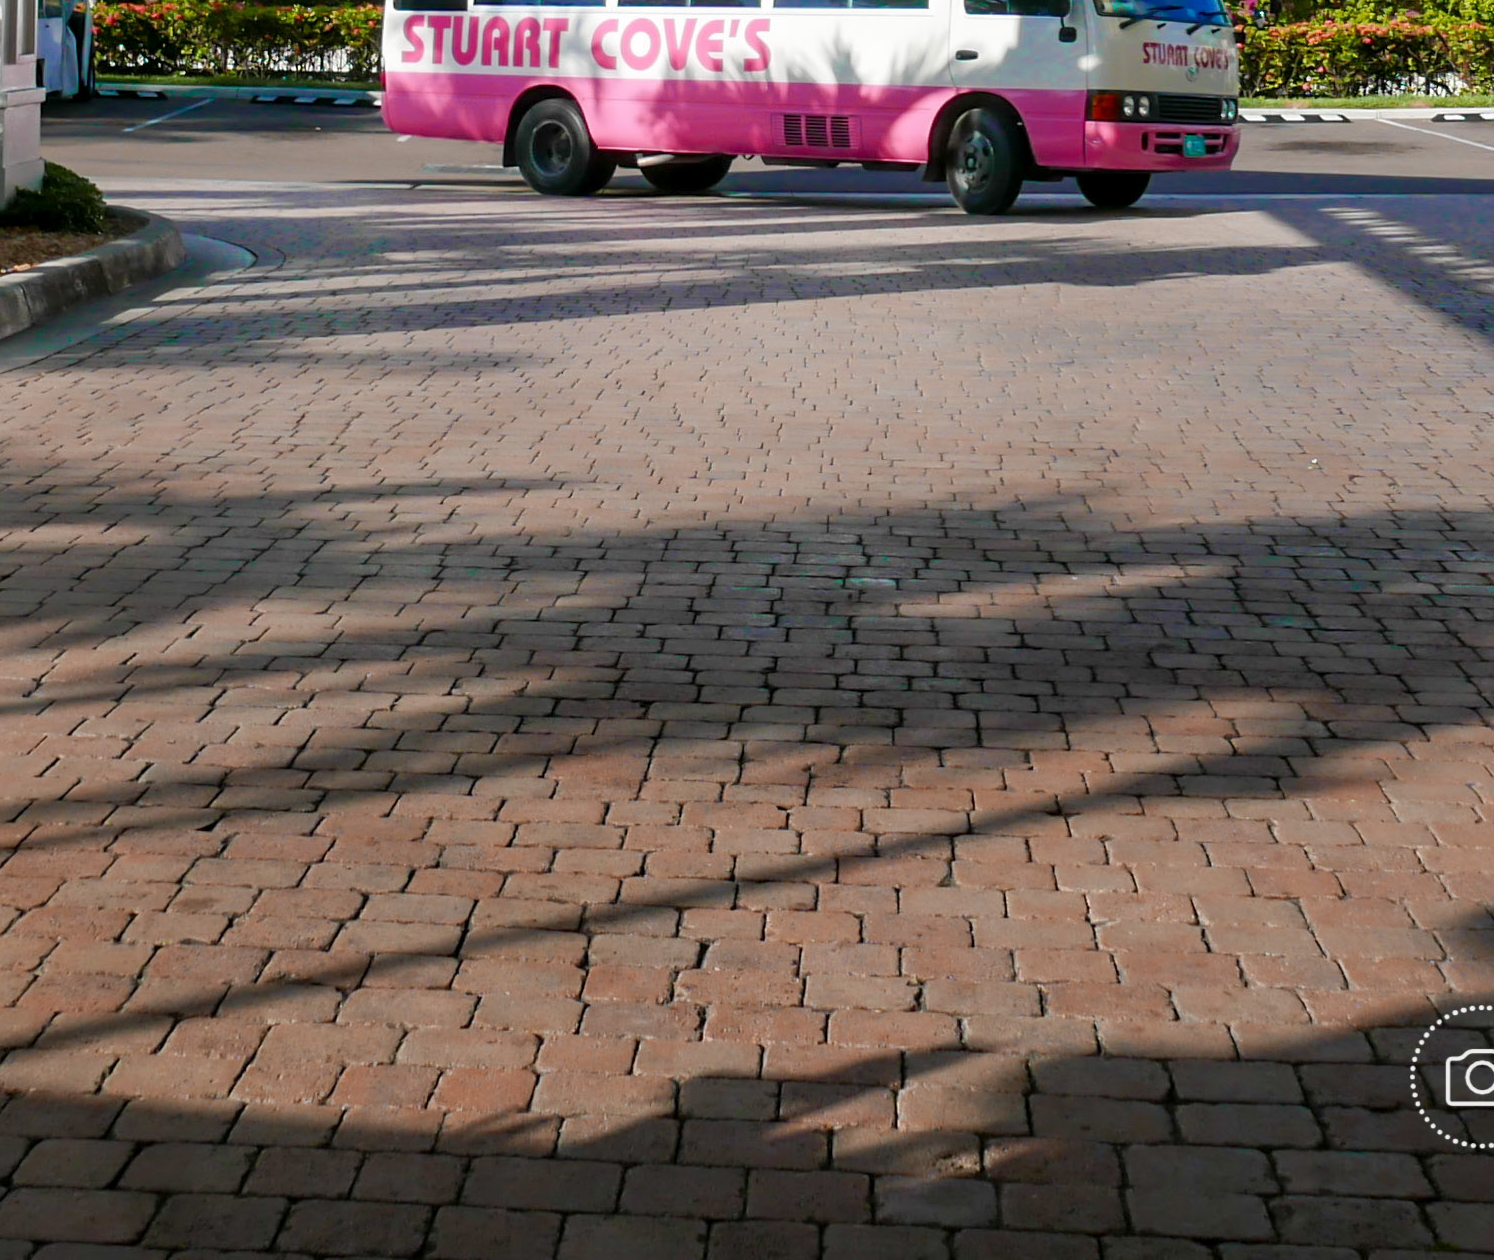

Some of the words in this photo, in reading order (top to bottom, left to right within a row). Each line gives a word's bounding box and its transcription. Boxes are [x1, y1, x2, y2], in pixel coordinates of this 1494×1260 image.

[400, 14, 569, 68] STUART
[591, 18, 771, 72] COVE'S
[1143, 42, 1188, 66] STUART
